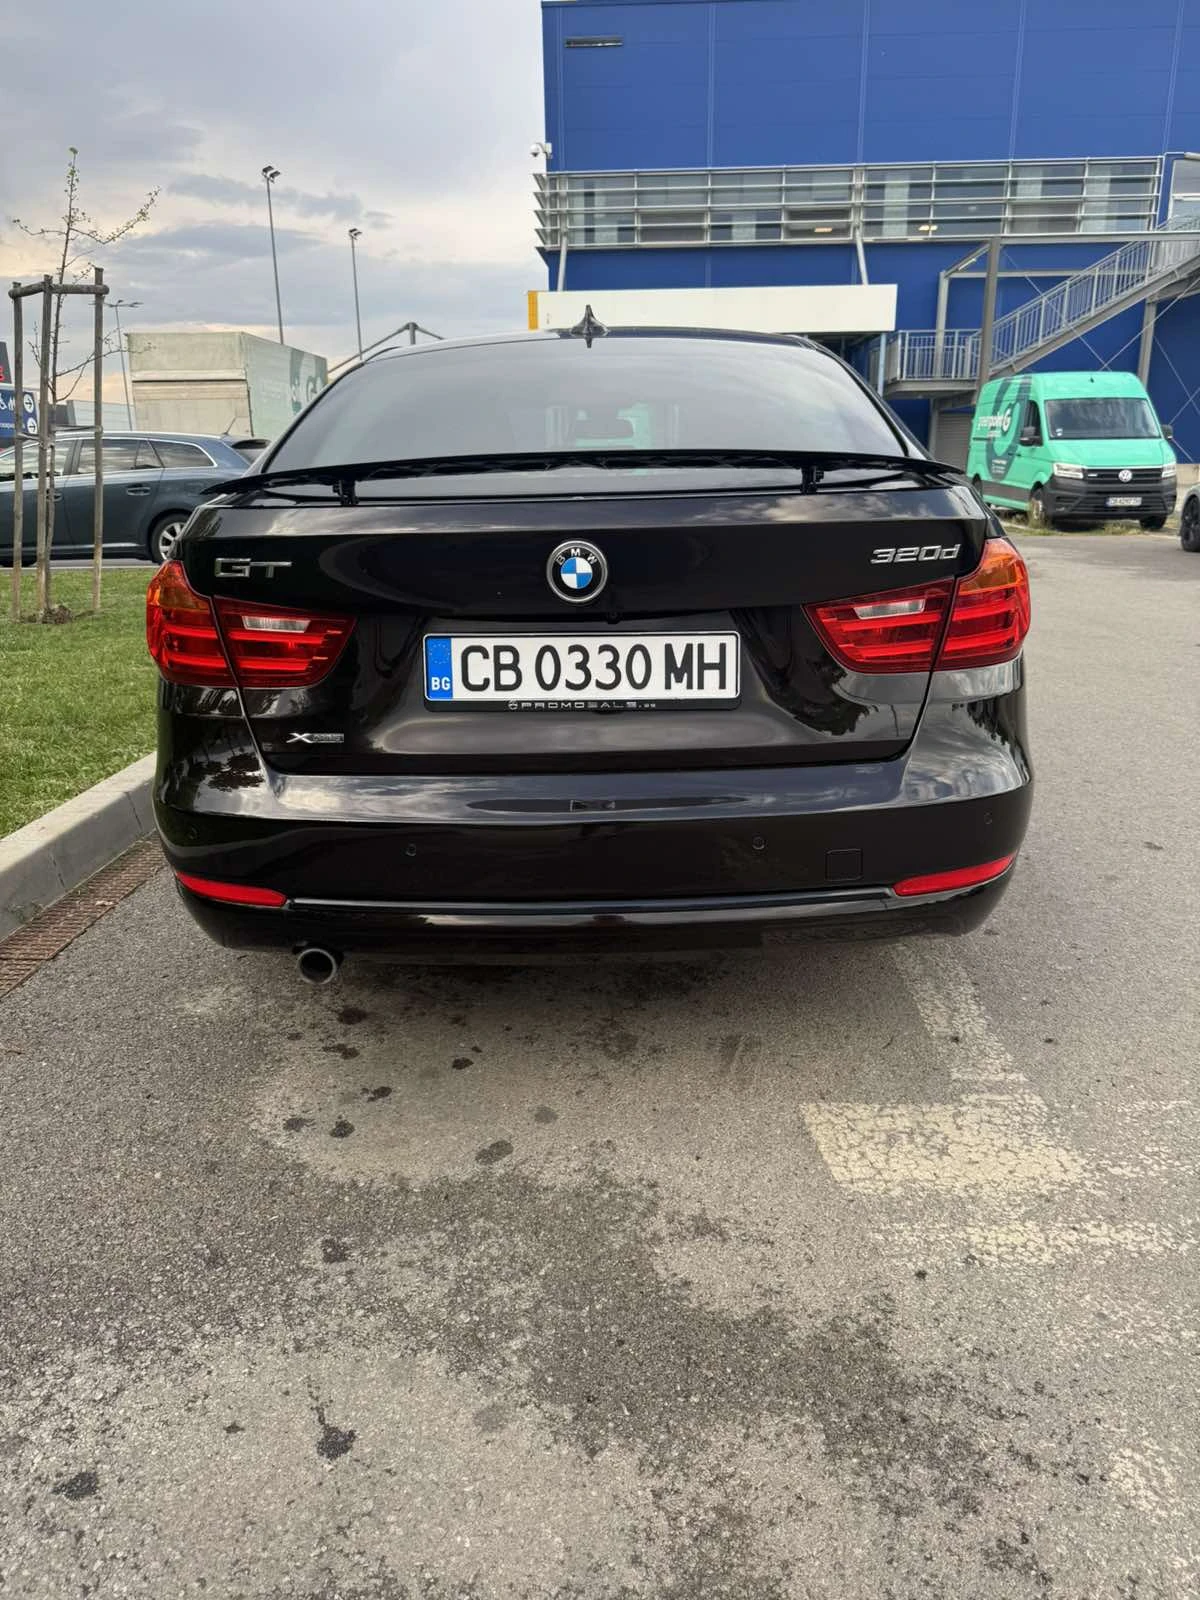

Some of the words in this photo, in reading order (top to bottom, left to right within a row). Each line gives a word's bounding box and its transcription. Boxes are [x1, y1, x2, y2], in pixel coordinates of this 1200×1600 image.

[554, 547, 598, 566] BMW
[870, 543, 961, 564] 320d
[215, 557, 292, 578] GT
[460, 644, 523, 692] CB
[534, 643, 652, 692] 0330
[664, 642, 727, 691] MH
[431, 678, 451, 691] BG
